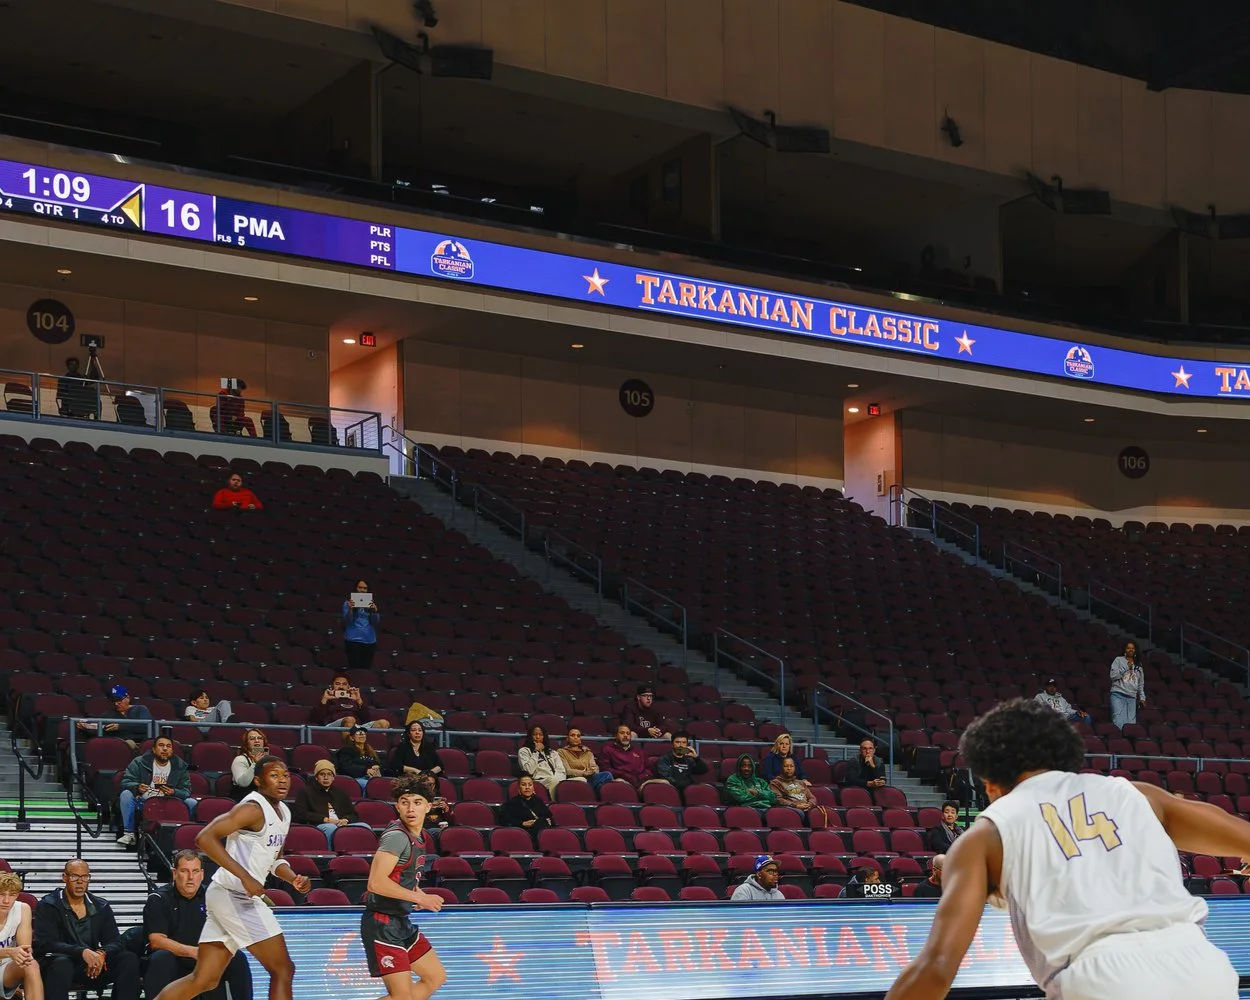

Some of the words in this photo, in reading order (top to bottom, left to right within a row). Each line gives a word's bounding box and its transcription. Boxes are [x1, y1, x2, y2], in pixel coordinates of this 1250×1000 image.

[22, 168, 91, 202] 1:09
[4, 198, 13, 208] 4
[33, 202, 63, 216] QTR
[72, 208, 79, 219] 1
[160, 199, 201, 231] 16
[101, 213, 110, 224] 4
[110, 215, 125, 225] TO
[233, 214, 286, 241] PMA
[370, 225, 391, 238] PLR
[217, 234, 232, 243] FLS
[237, 236, 246, 246] 5
[370, 240, 391, 252] PTS
[370, 254, 391, 266] PFL
[433, 257, 472, 269] TARKANIAN
[438, 263, 466, 274] CLASSIC
[635, 273, 814, 331] TARKANIAN
[828, 306, 940, 351] CLASSIC
[33, 311, 69, 332] 104
[624, 390, 650, 407] 105
[1121, 456, 1146, 470] 106
[1038, 791, 1123, 861] 14
[863, 884, 893, 895] POSS
[576, 924, 909, 982] TARKANIAN
